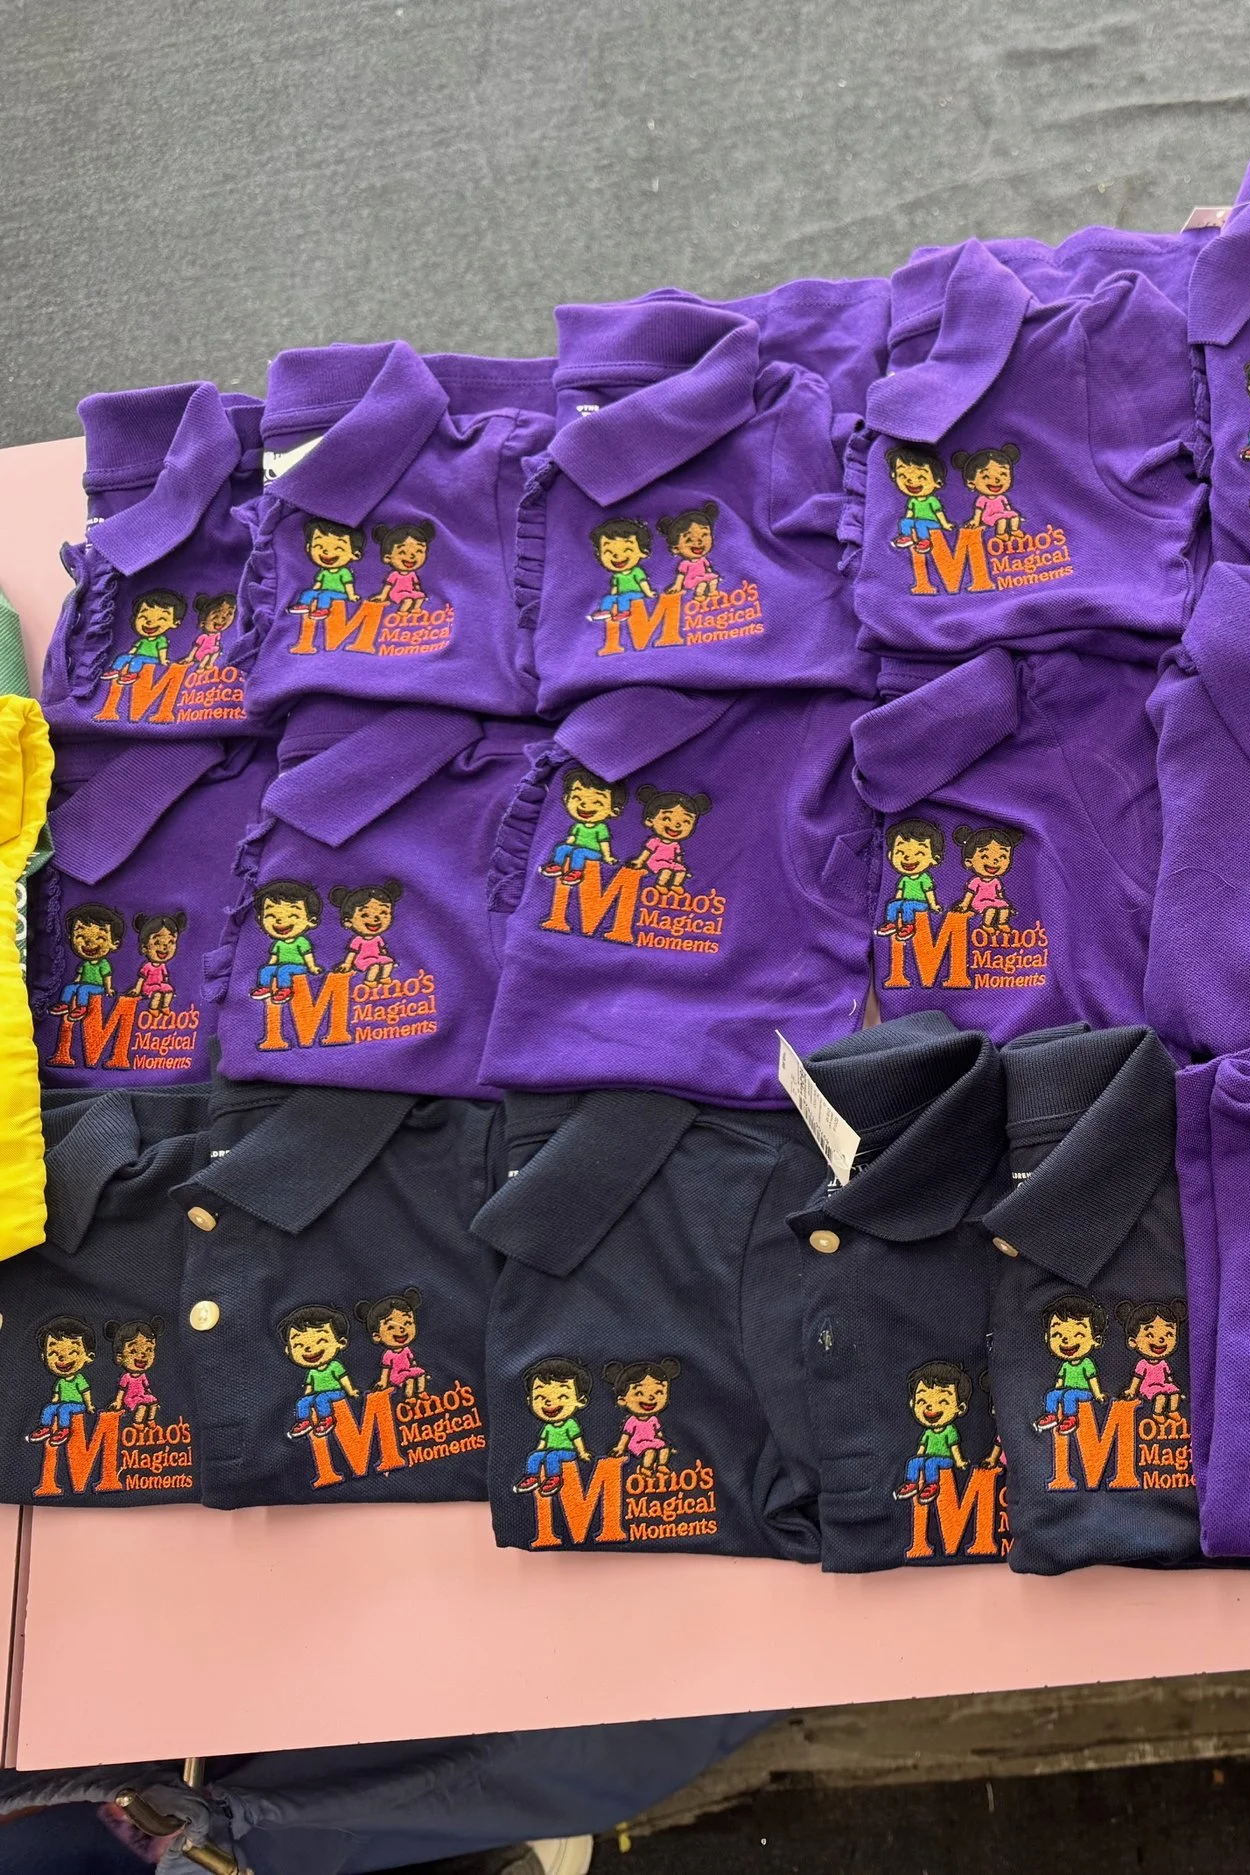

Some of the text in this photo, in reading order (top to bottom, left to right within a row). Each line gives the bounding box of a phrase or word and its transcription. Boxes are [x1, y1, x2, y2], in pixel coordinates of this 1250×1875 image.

[911, 524, 1067, 595] Momo's
[990, 546, 1070, 574] Magical
[997, 564, 1074, 591] Moments
[597, 580, 759, 656] Momo's
[682, 602, 762, 631] Magical
[378, 626, 450, 644] Magica
[686, 622, 764, 648] Moments
[93, 662, 245, 723] Momo
[177, 684, 244, 707] Magica
[541, 859, 726, 944] Momo's
[636, 908, 722, 936] Magical
[636, 931, 719, 954] Moments
[884, 910, 1049, 989] Momo's
[970, 949, 1049, 974] Magical
[974, 972, 1046, 990] Moments
[258, 970, 435, 1051] Momo's
[351, 995, 437, 1025] Magical
[49, 994, 199, 1069] Momo's
[131, 1030, 197, 1056] Magical
[354, 1019, 437, 1044] Moments
[133, 1055, 192, 1071] Moments
[309, 1381, 475, 1489] Momo's
[399, 1408, 482, 1446] Magical
[34, 1410, 191, 1496] Momo's
[408, 1434, 486, 1467] Moments
[1048, 1399, 1191, 1489] Mom
[121, 1446, 192, 1473] Magical
[126, 1474, 193, 1491] Moments
[531, 1456, 714, 1548] Momo's
[625, 1491, 717, 1521] Magical
[629, 1518, 718, 1541] Moments
